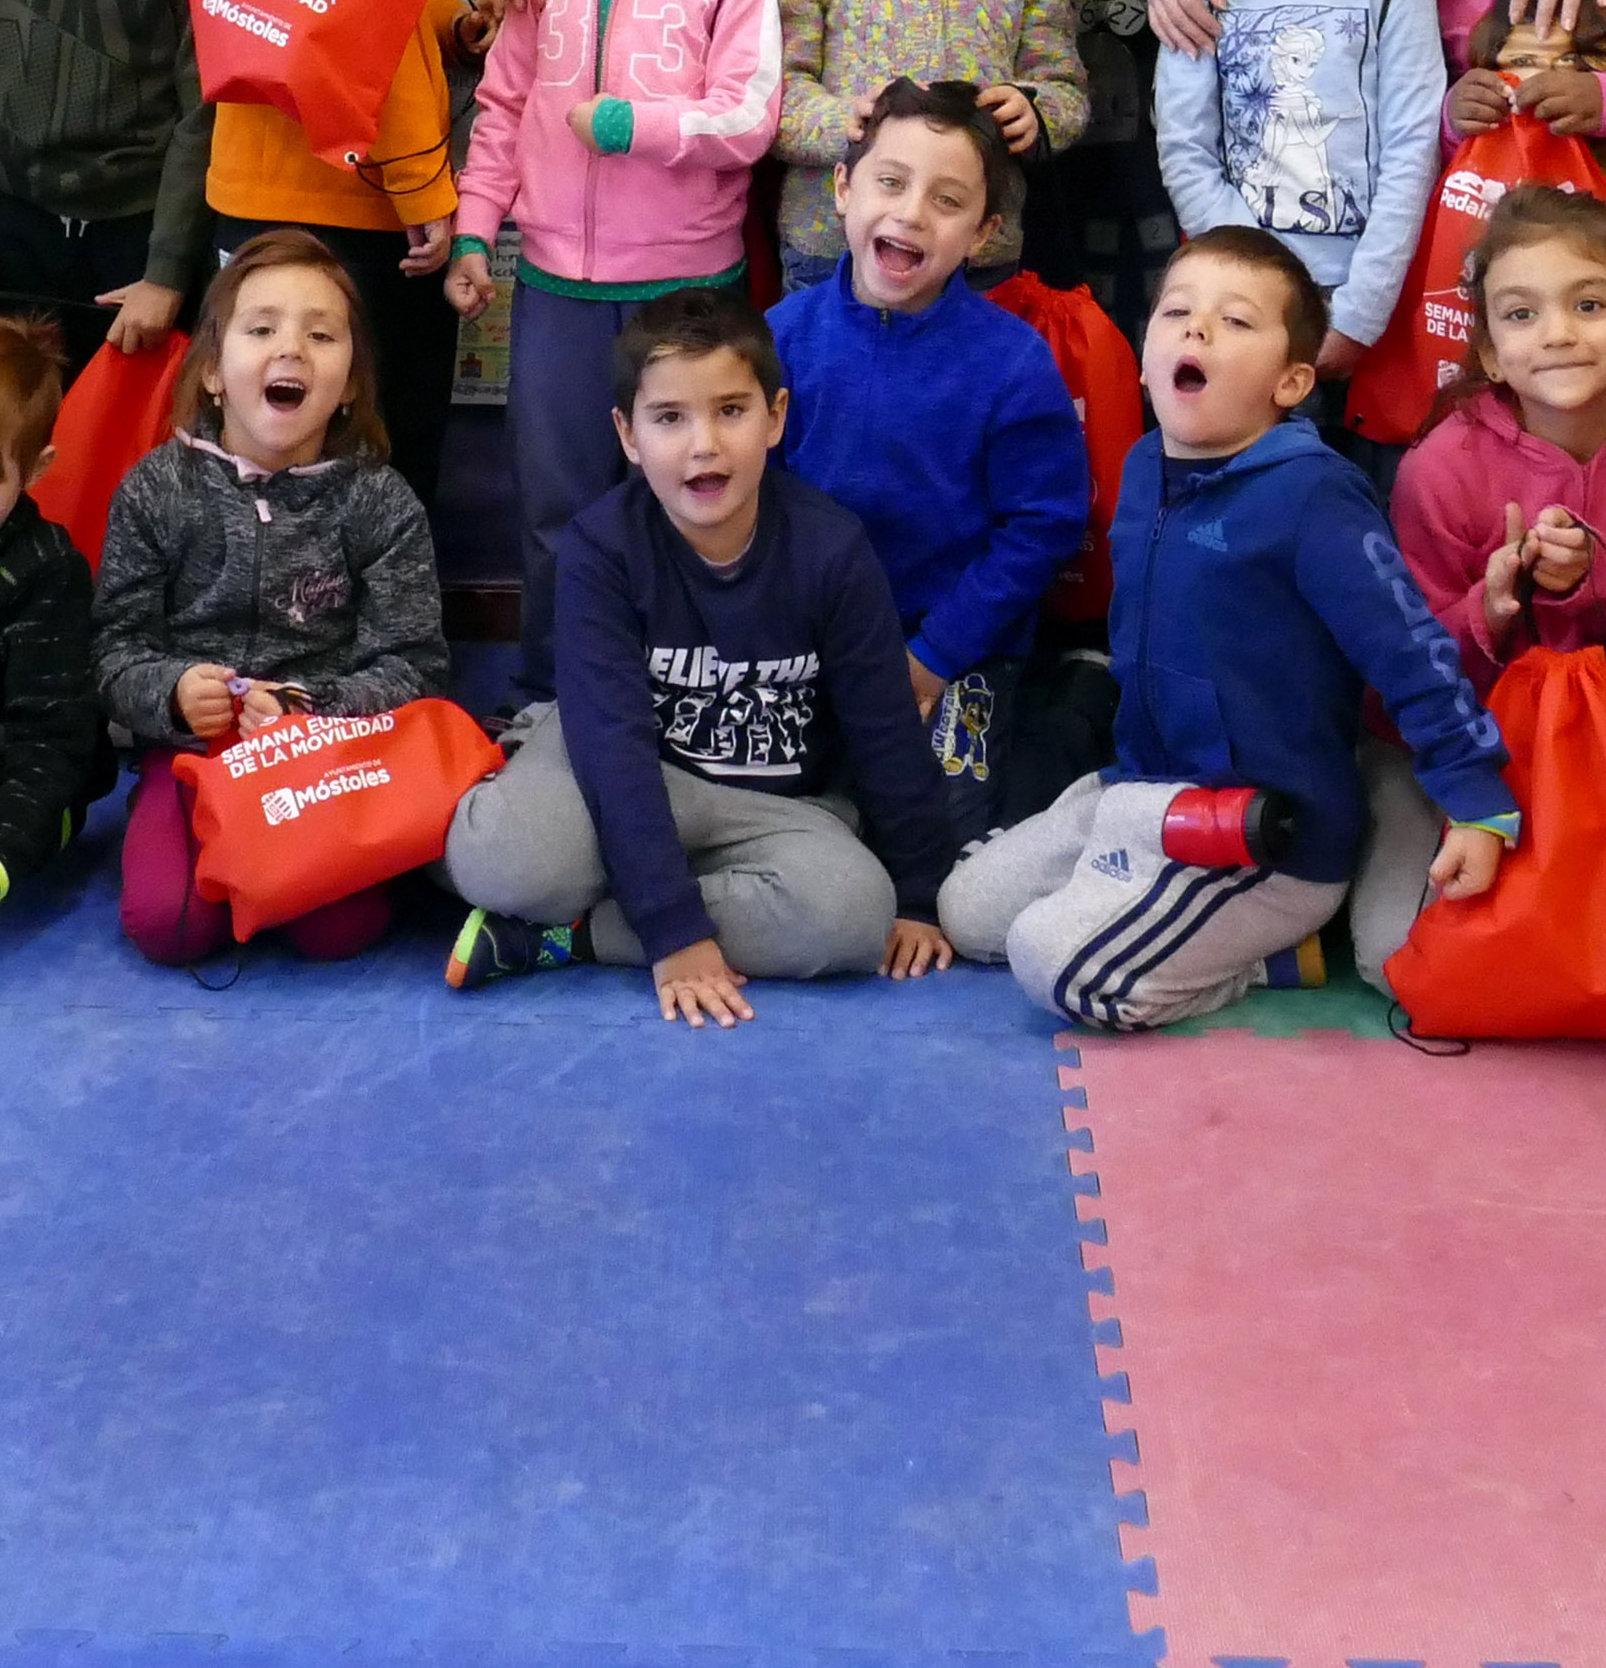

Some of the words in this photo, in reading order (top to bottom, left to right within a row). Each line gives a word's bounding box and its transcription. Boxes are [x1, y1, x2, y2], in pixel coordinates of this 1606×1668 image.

[1107, 0, 1146, 30] 27
[1424, 301, 1476, 327] SEMAN
[1425, 319, 1446, 335] DE
[755, 650, 821, 683] THE
[221, 726, 305, 767] SEMANA
[228, 755, 258, 780] DE
[260, 747, 286, 769] LA
[289, 715, 395, 759] MOVILIDAD
[295, 766, 391, 811] Móstoles
[1090, 858, 1134, 883] adidas
